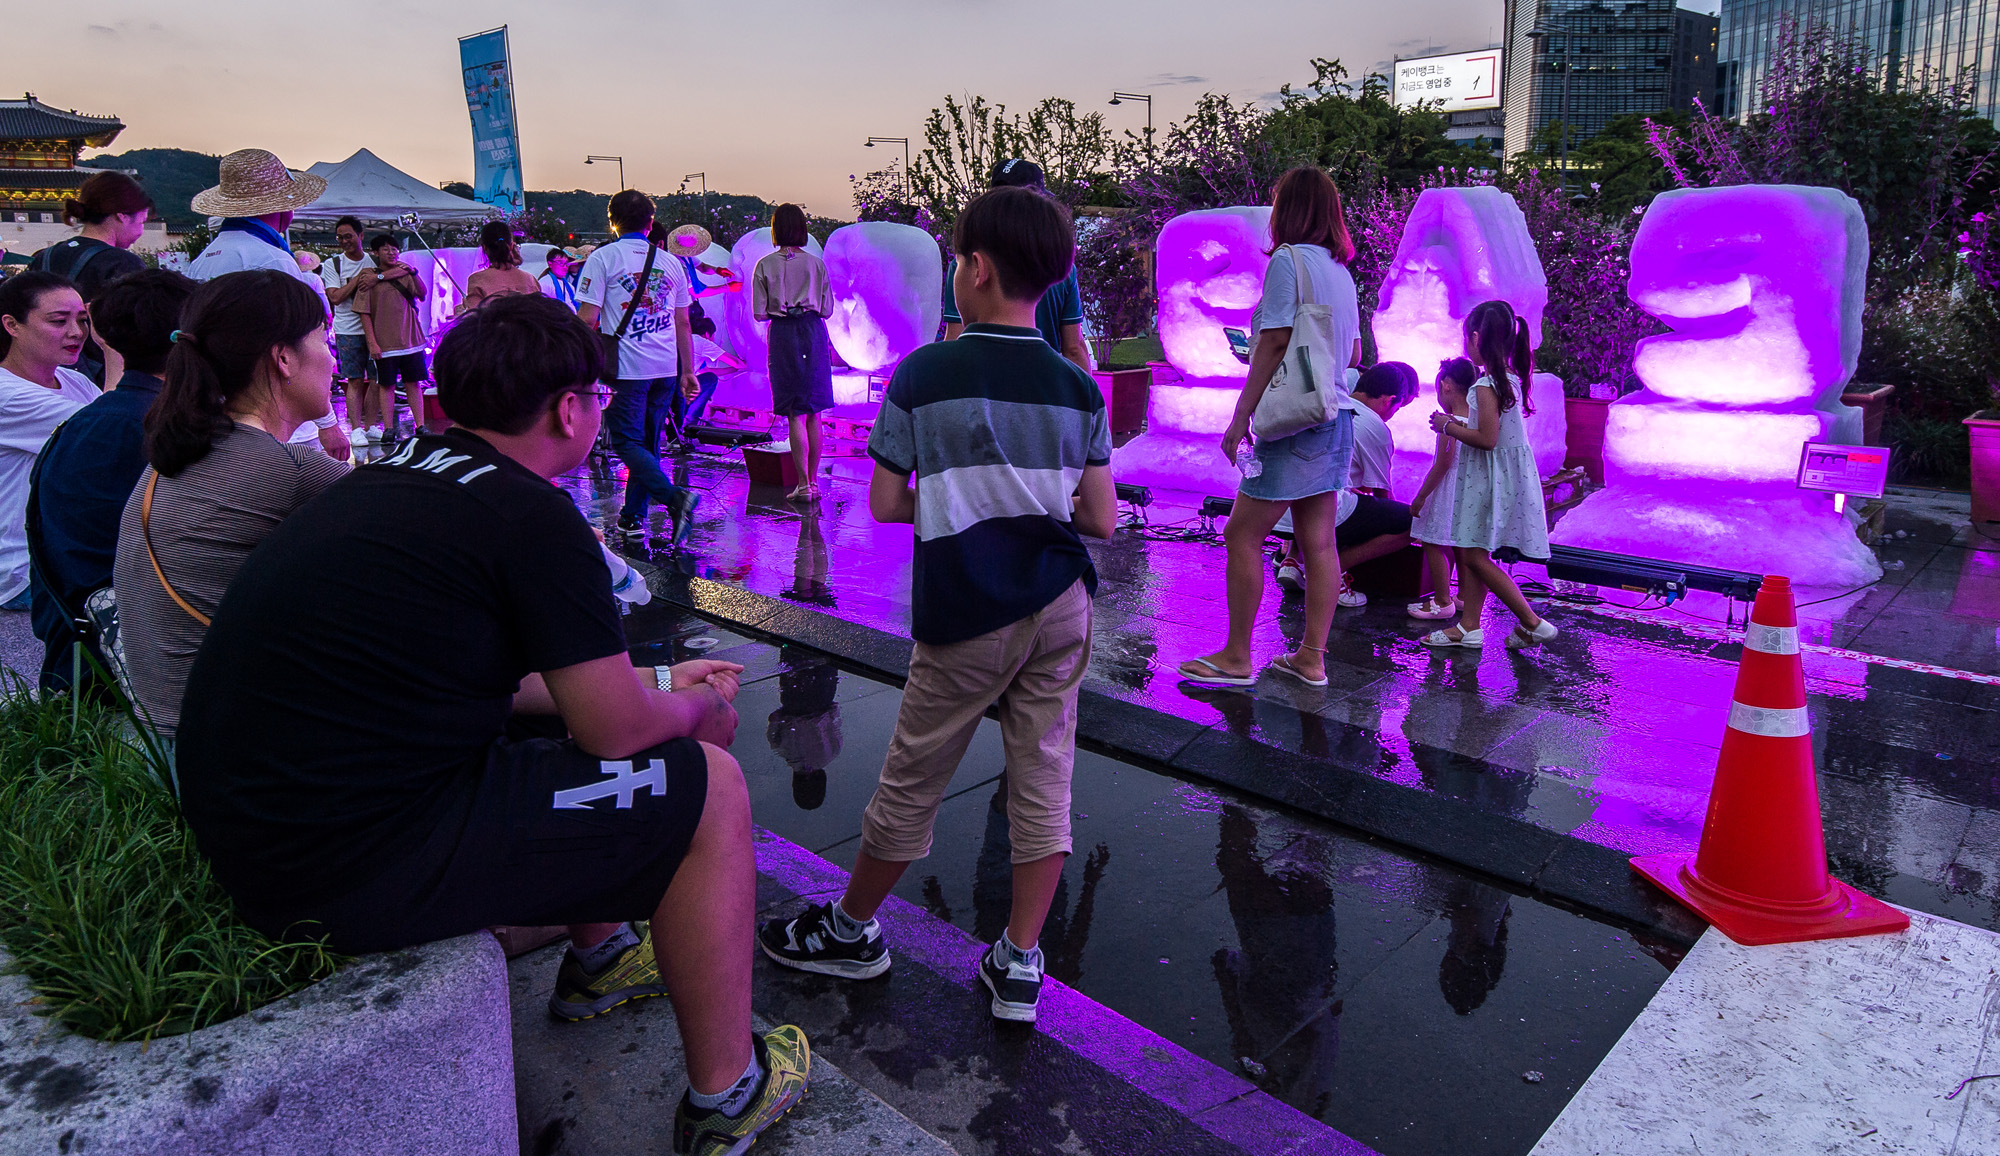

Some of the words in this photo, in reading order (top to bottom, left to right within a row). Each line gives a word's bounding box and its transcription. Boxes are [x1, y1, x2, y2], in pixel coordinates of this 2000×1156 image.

[1401, 65, 1445, 78] 케이뱅크는
[1400, 81, 1424, 92] 지금도
[1425, 79, 1442, 90] 영업
[1443, 77, 1452, 88] 중
[629, 312, 672, 342] 부라보
[370, 437, 498, 484] AMI
